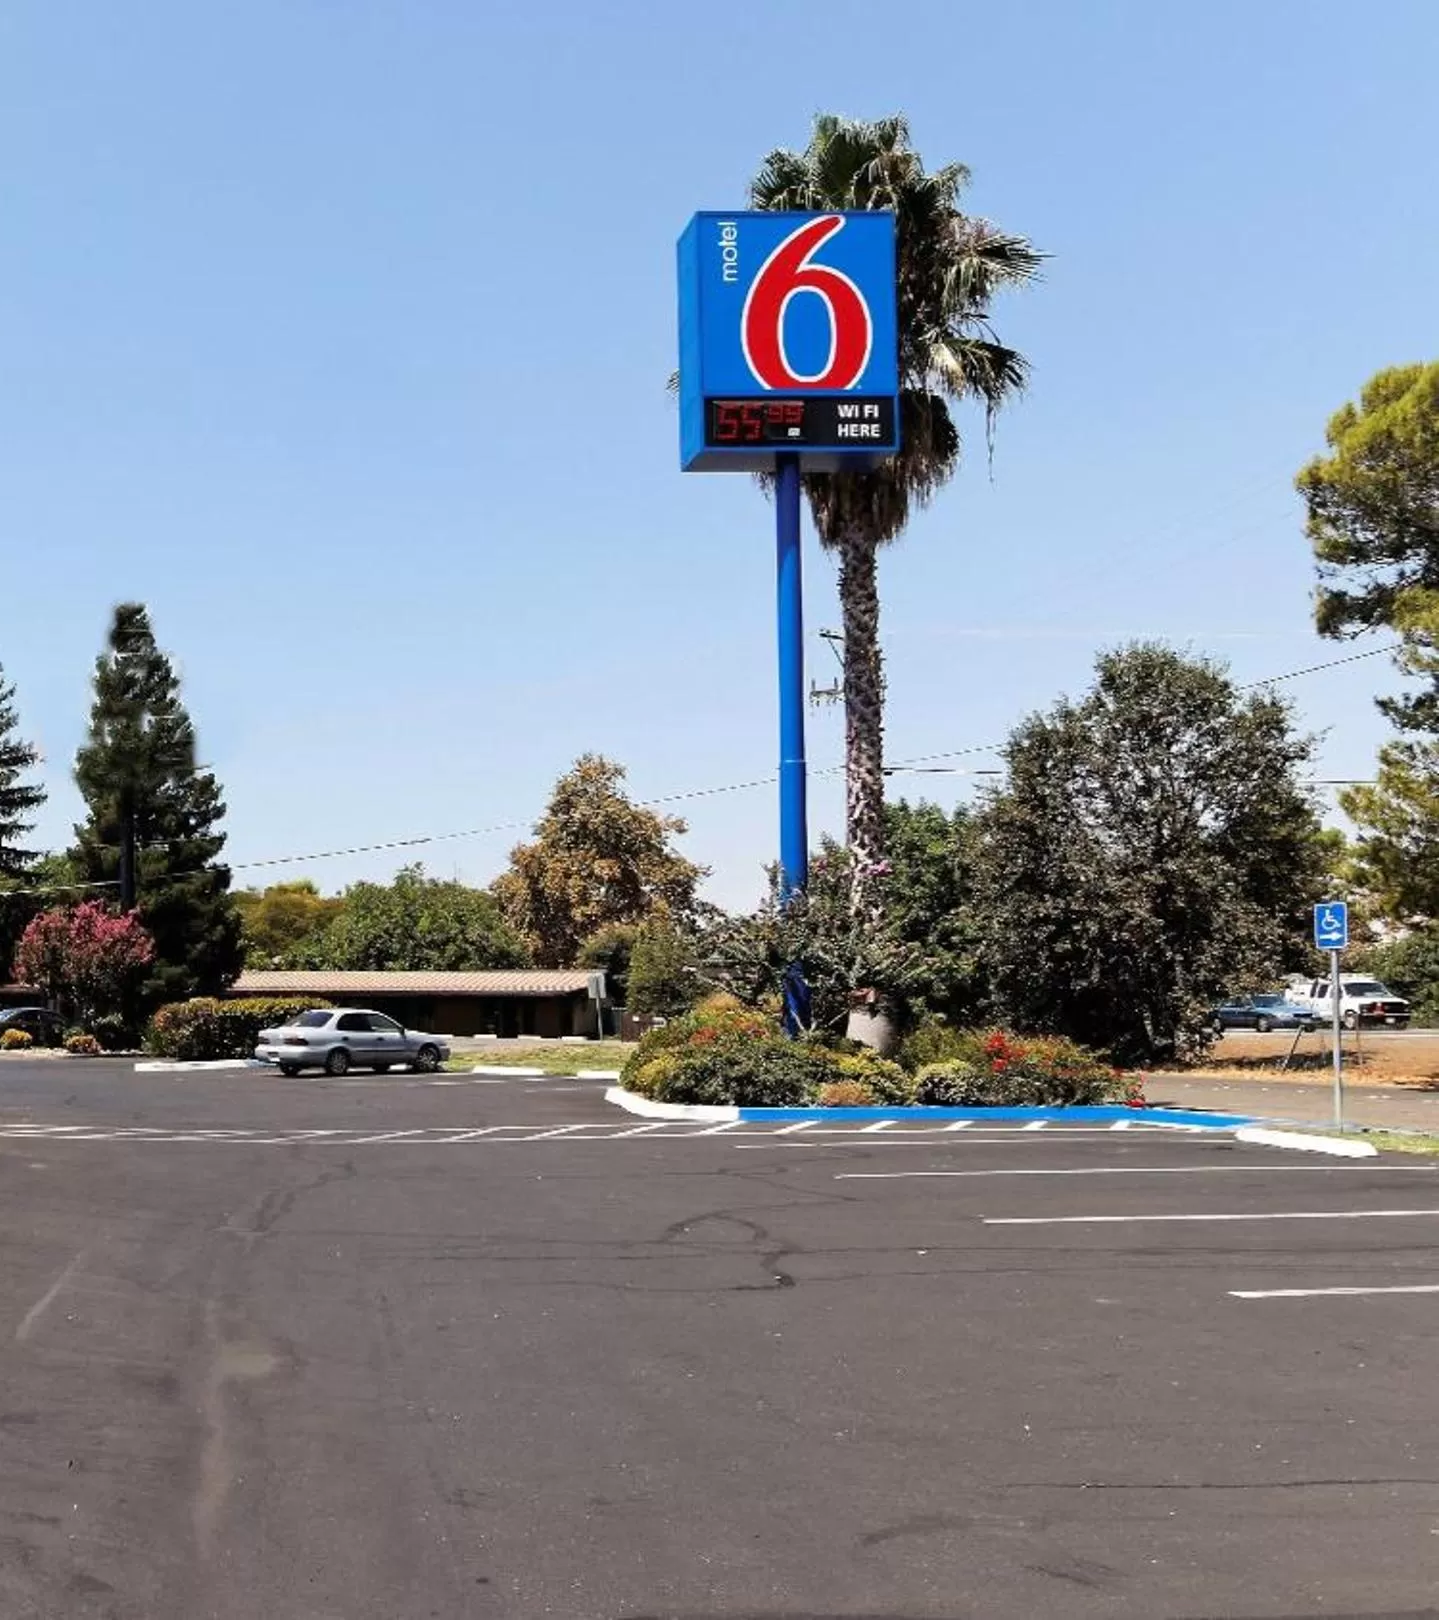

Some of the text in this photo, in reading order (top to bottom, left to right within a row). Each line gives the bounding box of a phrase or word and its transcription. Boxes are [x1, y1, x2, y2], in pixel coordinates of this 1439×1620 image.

[717, 221, 738, 282] motel
[741, 214, 873, 390] 6
[836, 403, 879, 418] WI FI
[837, 423, 881, 438] HERE
